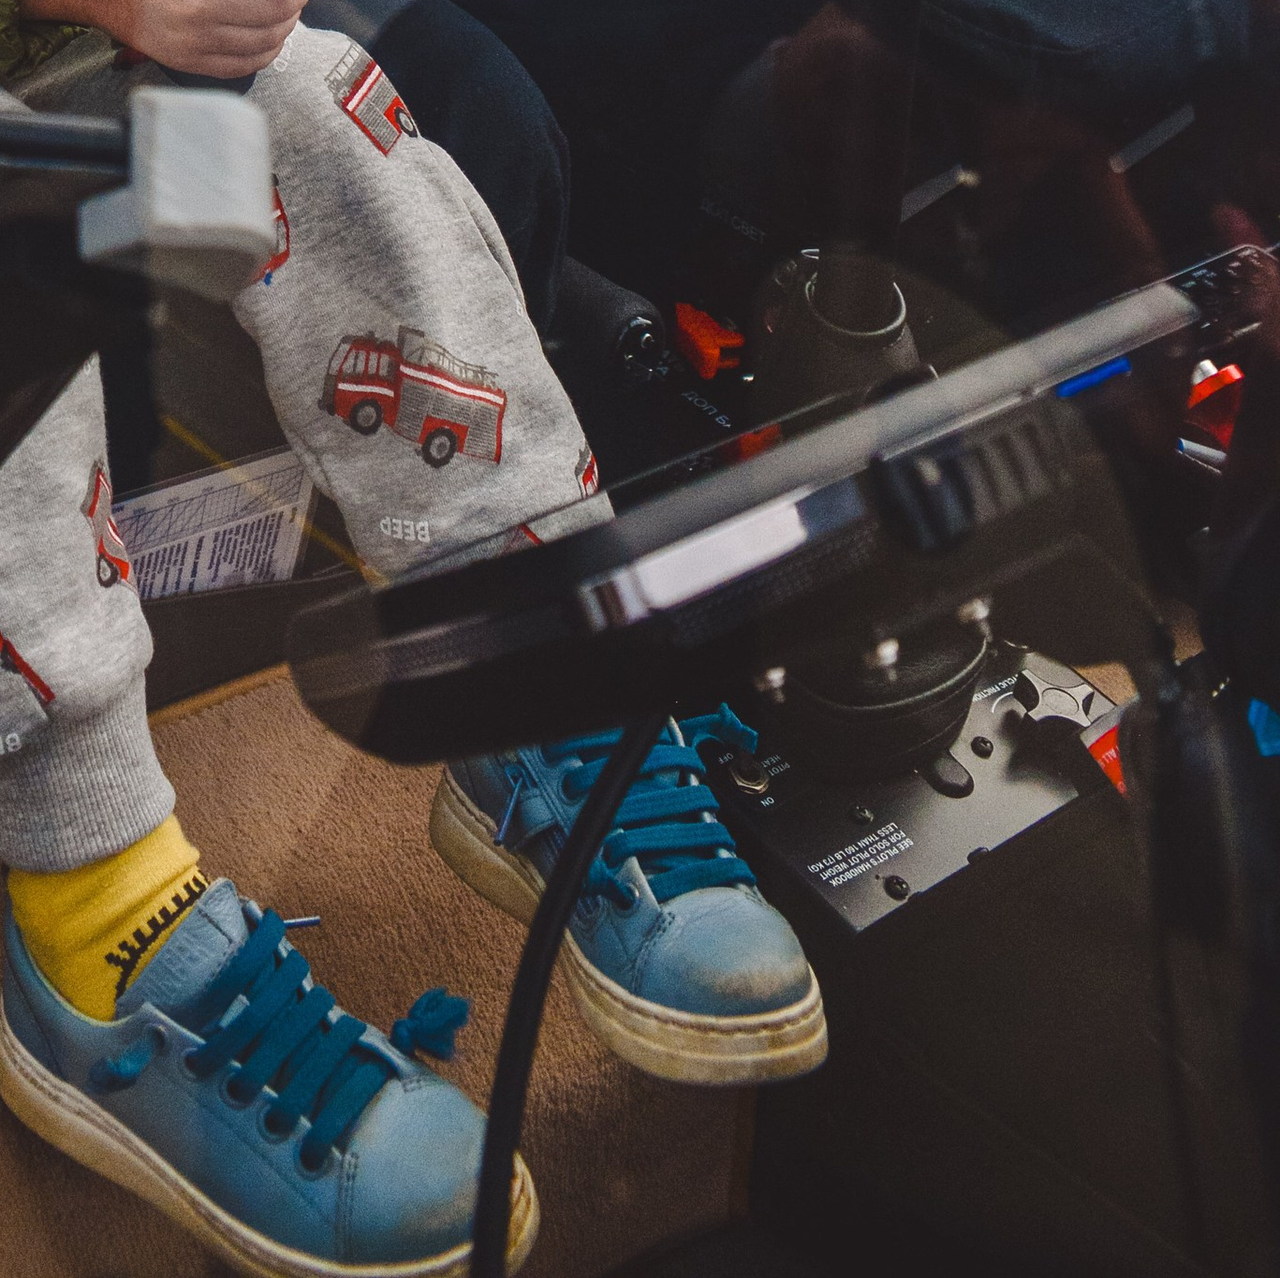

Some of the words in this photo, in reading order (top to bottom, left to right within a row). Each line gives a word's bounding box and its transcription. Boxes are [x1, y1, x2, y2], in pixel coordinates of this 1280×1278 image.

[379, 516, 430, 542] BEEP
[716, 750, 734, 765] OFF
[760, 752, 780, 768] HEAT
[767, 759, 790, 777] PITOT
[759, 794, 775, 808] ON
[877, 823, 898, 837] LESS
[889, 830, 906, 843] FOR
[858, 834, 879, 847] THAN
[868, 840, 890, 854] SOLO
[897, 838, 914, 851] SEE
[823, 854, 835, 866] (73
[834, 850, 846, 860] LB
[848, 851, 870, 865] PILOT
[870, 847, 899, 866] PILOT'S
[807, 861, 825, 873] KG)
[819, 861, 849, 880] WEIGHT
[829, 863, 871, 886] HANDBOOK
